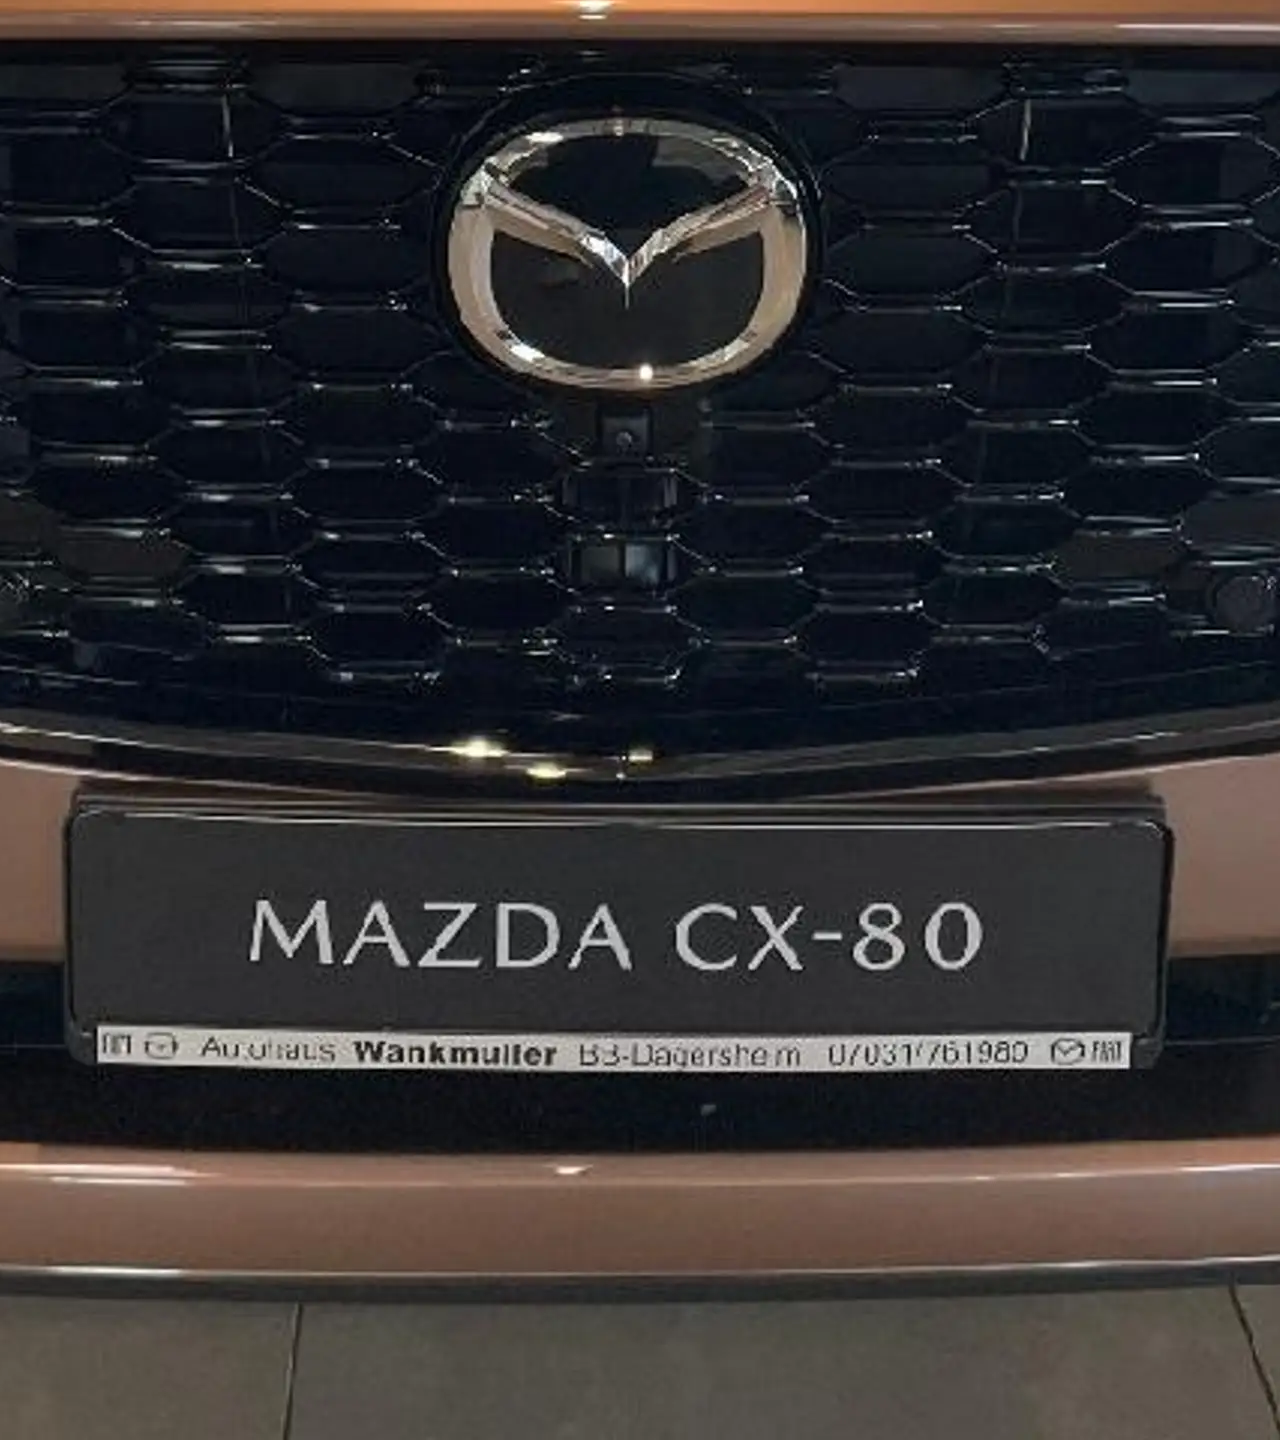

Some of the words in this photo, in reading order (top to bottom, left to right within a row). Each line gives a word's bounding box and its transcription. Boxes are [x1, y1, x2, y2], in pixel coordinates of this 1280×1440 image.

[250, 899, 632, 971] MAZDA
[675, 902, 983, 971] CX-80
[579, 1042, 802, 1071] BB-Dagershem
